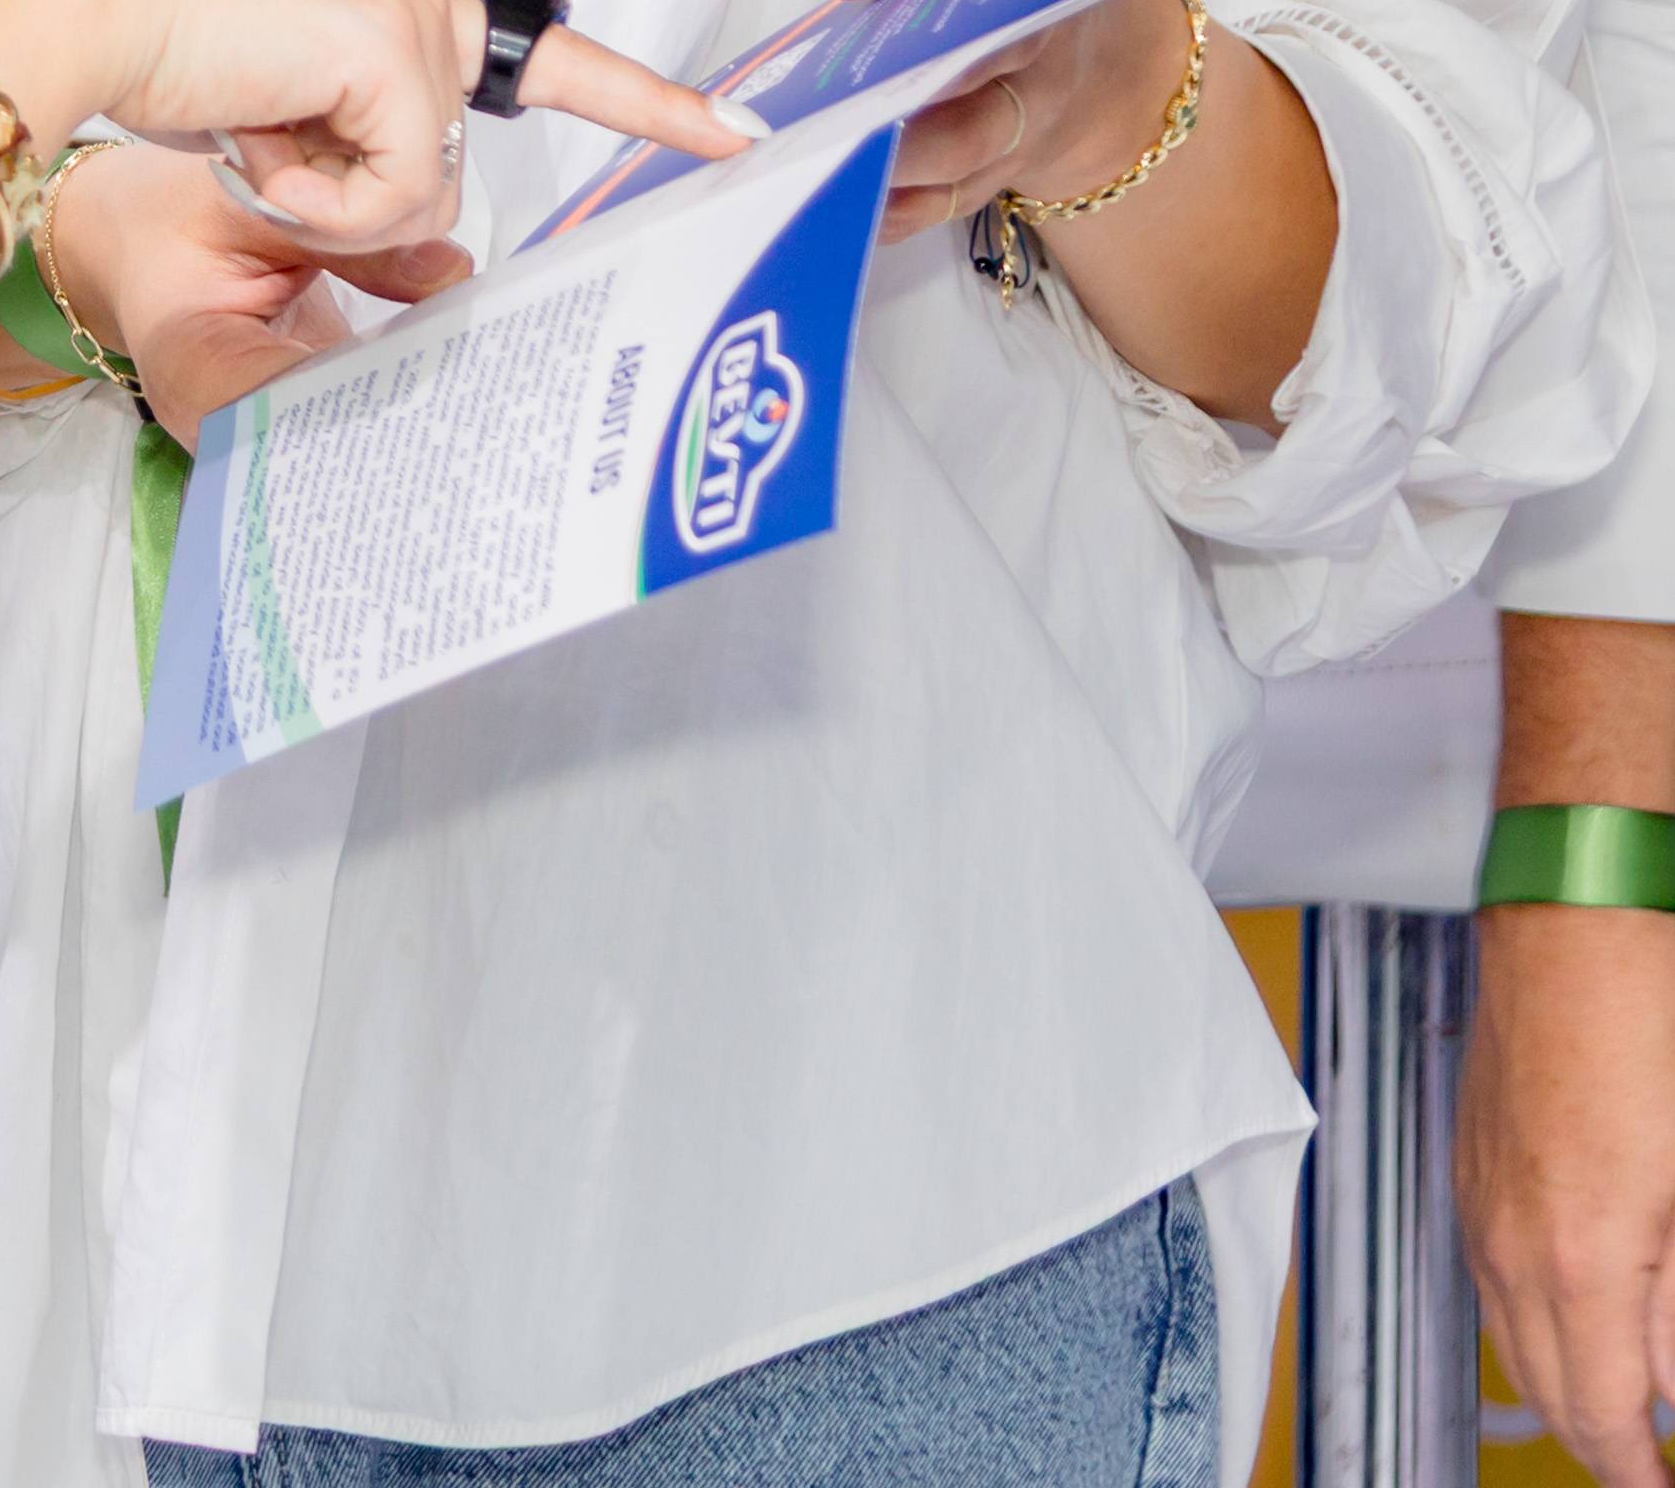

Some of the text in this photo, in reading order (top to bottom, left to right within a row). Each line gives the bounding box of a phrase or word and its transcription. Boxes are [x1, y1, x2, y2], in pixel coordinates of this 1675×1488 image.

[590, 343, 645, 494] ABOUT US
[696, 338, 758, 527] BEYTI
